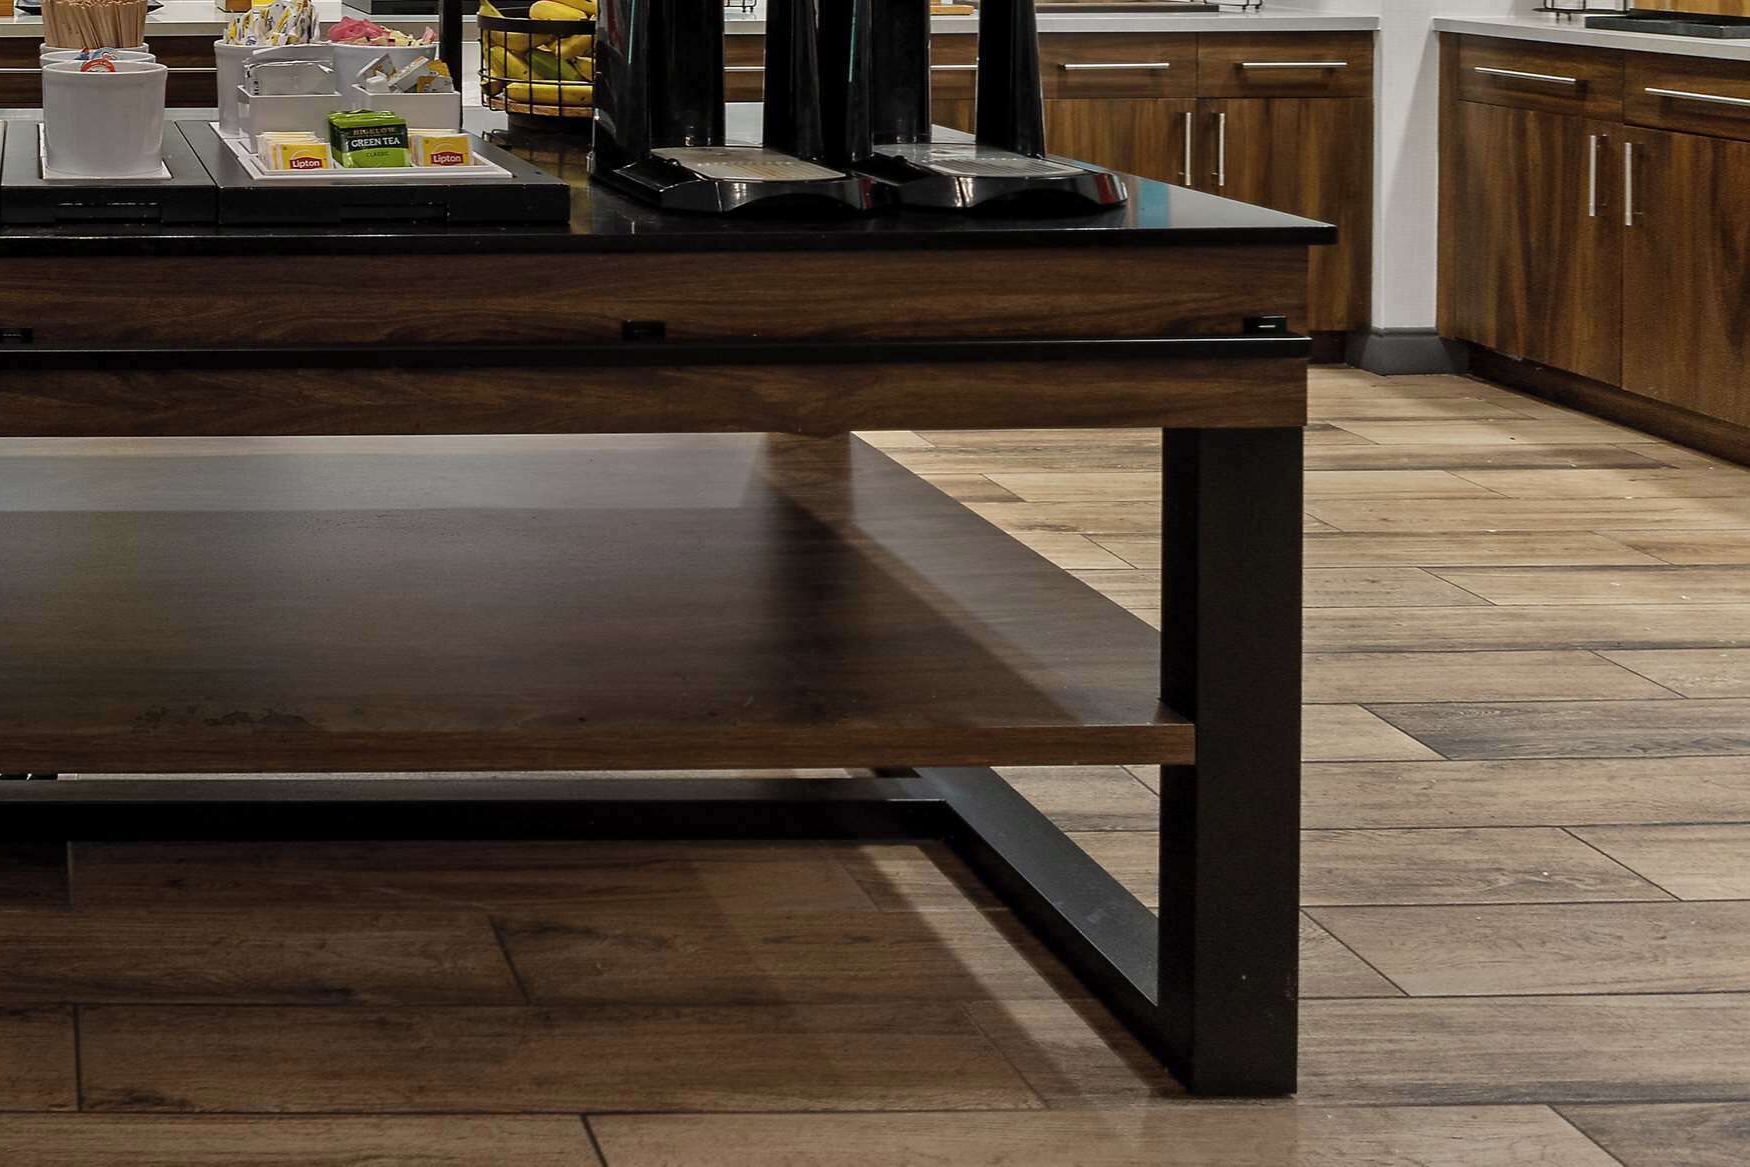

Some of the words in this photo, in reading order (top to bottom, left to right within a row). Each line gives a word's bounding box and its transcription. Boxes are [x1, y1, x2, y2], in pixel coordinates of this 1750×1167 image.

[353, 127, 397, 136] BIGELOW
[351, 138, 382, 148] GREEN
[382, 136, 401, 145] TEA
[292, 159, 321, 170] Lipton
[433, 153, 462, 165] Lipton
